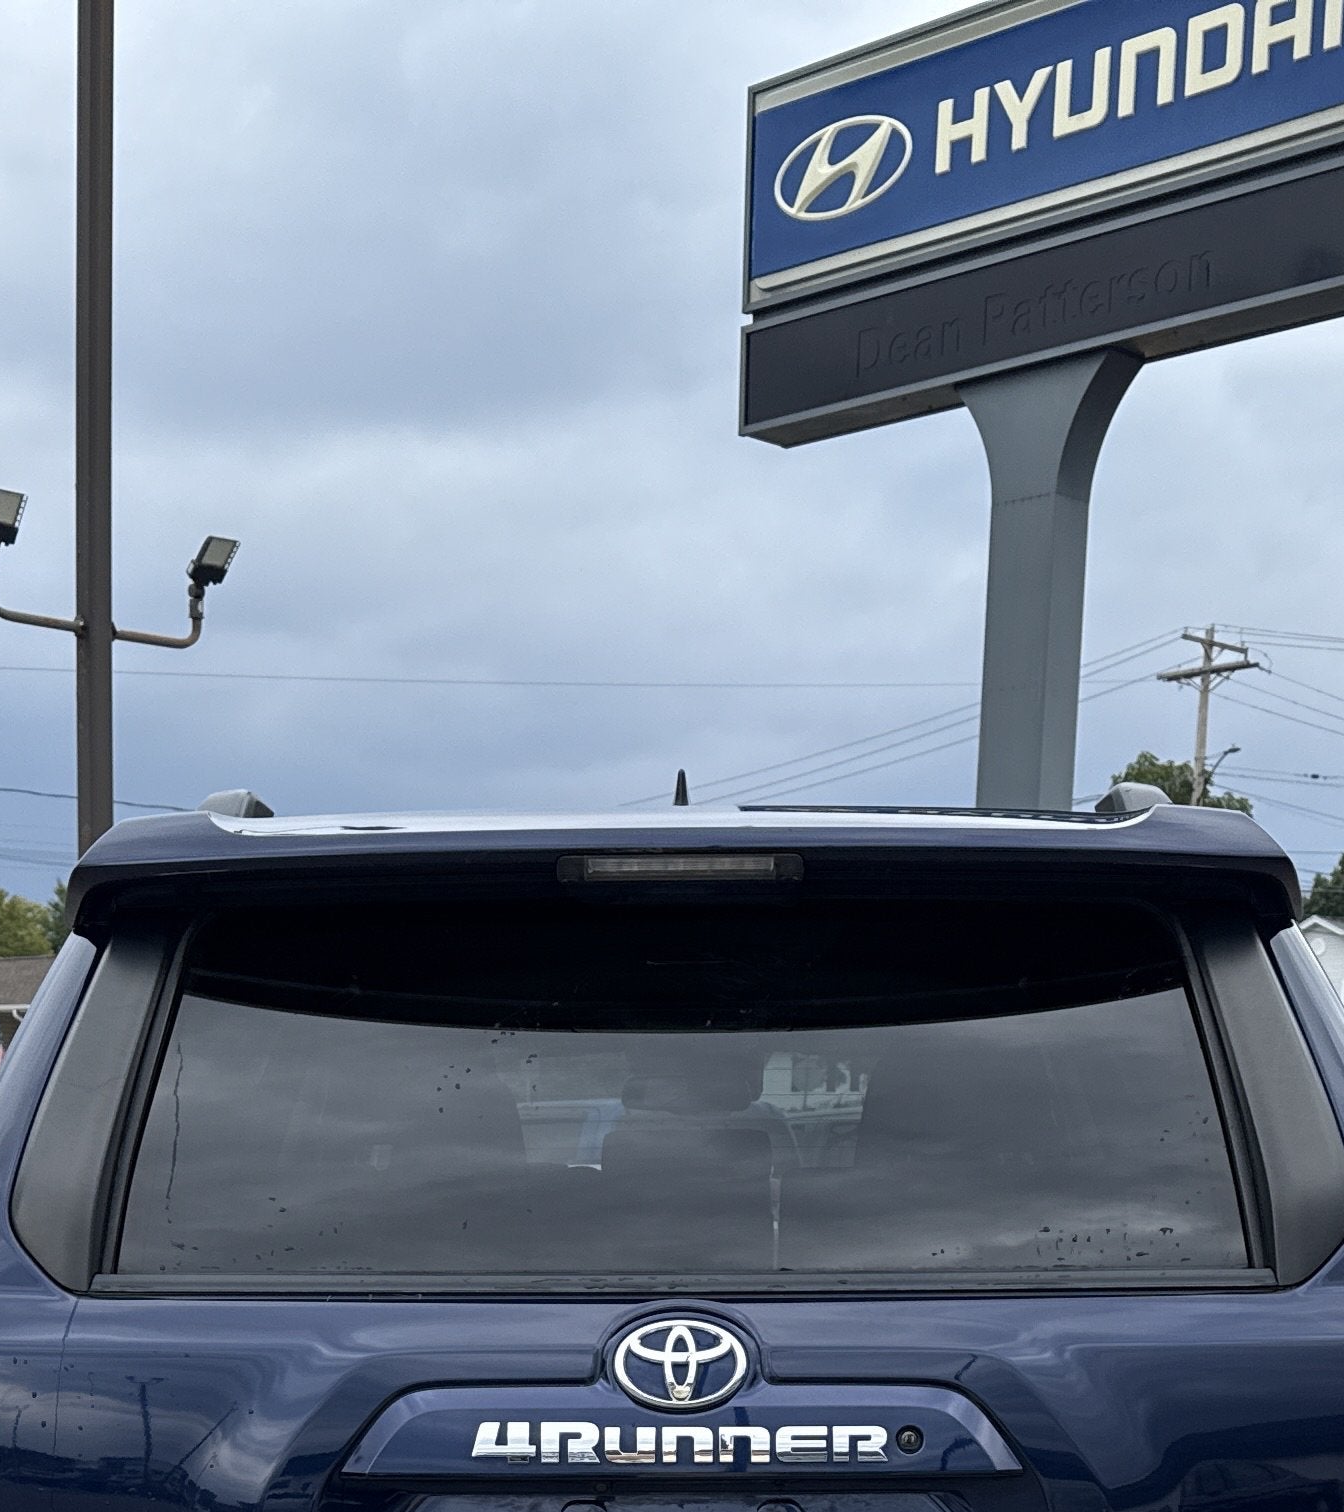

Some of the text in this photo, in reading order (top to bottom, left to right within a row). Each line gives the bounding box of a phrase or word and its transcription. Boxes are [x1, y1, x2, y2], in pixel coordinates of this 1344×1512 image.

[935, 0, 1344, 174] HYUNDAI
[856, 250, 1212, 378] Dean Patterson
